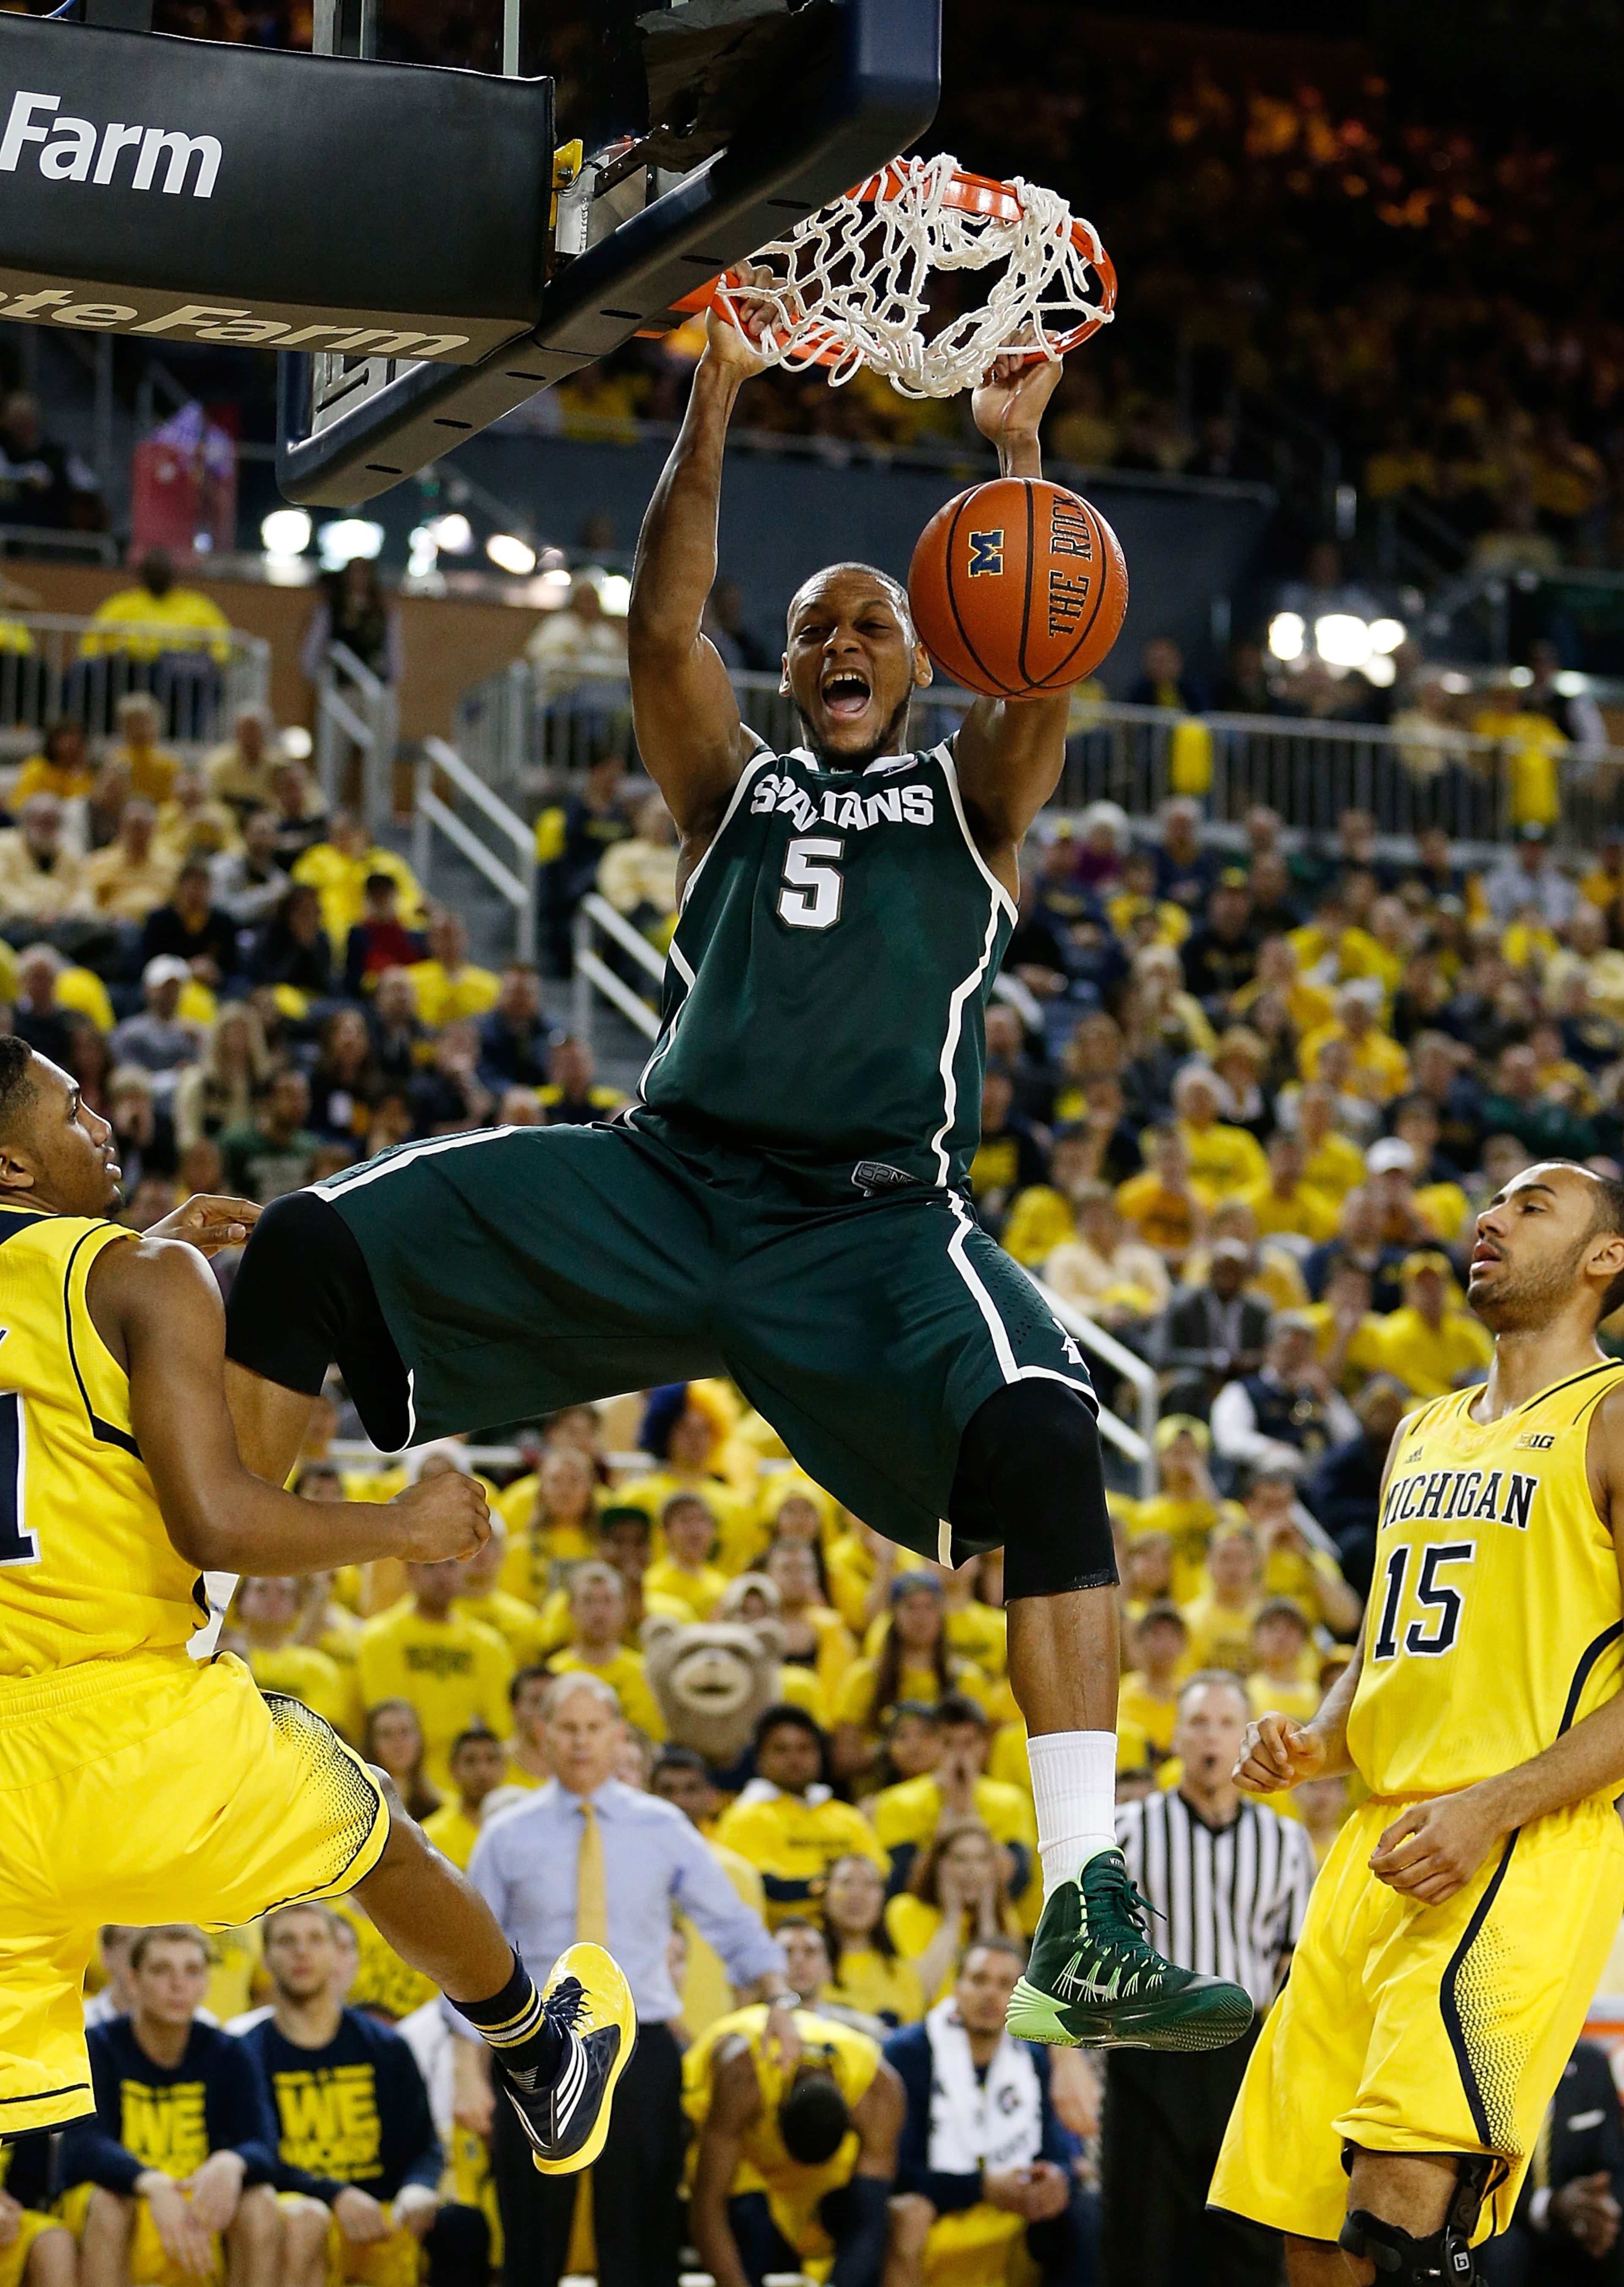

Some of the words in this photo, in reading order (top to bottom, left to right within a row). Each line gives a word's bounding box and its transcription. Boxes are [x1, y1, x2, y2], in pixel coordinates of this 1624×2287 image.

[0, 90, 223, 198] Farm
[0, 289, 138, 326] te
[130, 305, 470, 356] Farm
[968, 529, 1004, 578] M
[1050, 494, 1092, 562] ROCK
[1048, 569, 1091, 638] THE
[776, 836, 845, 930] 5
[890, 1171, 914, 1184] NIK
[1380, 1469, 1539, 1532] MICHIGAN
[1373, 1540, 1477, 1662] 15
[276, 2080, 379, 2140] WE
